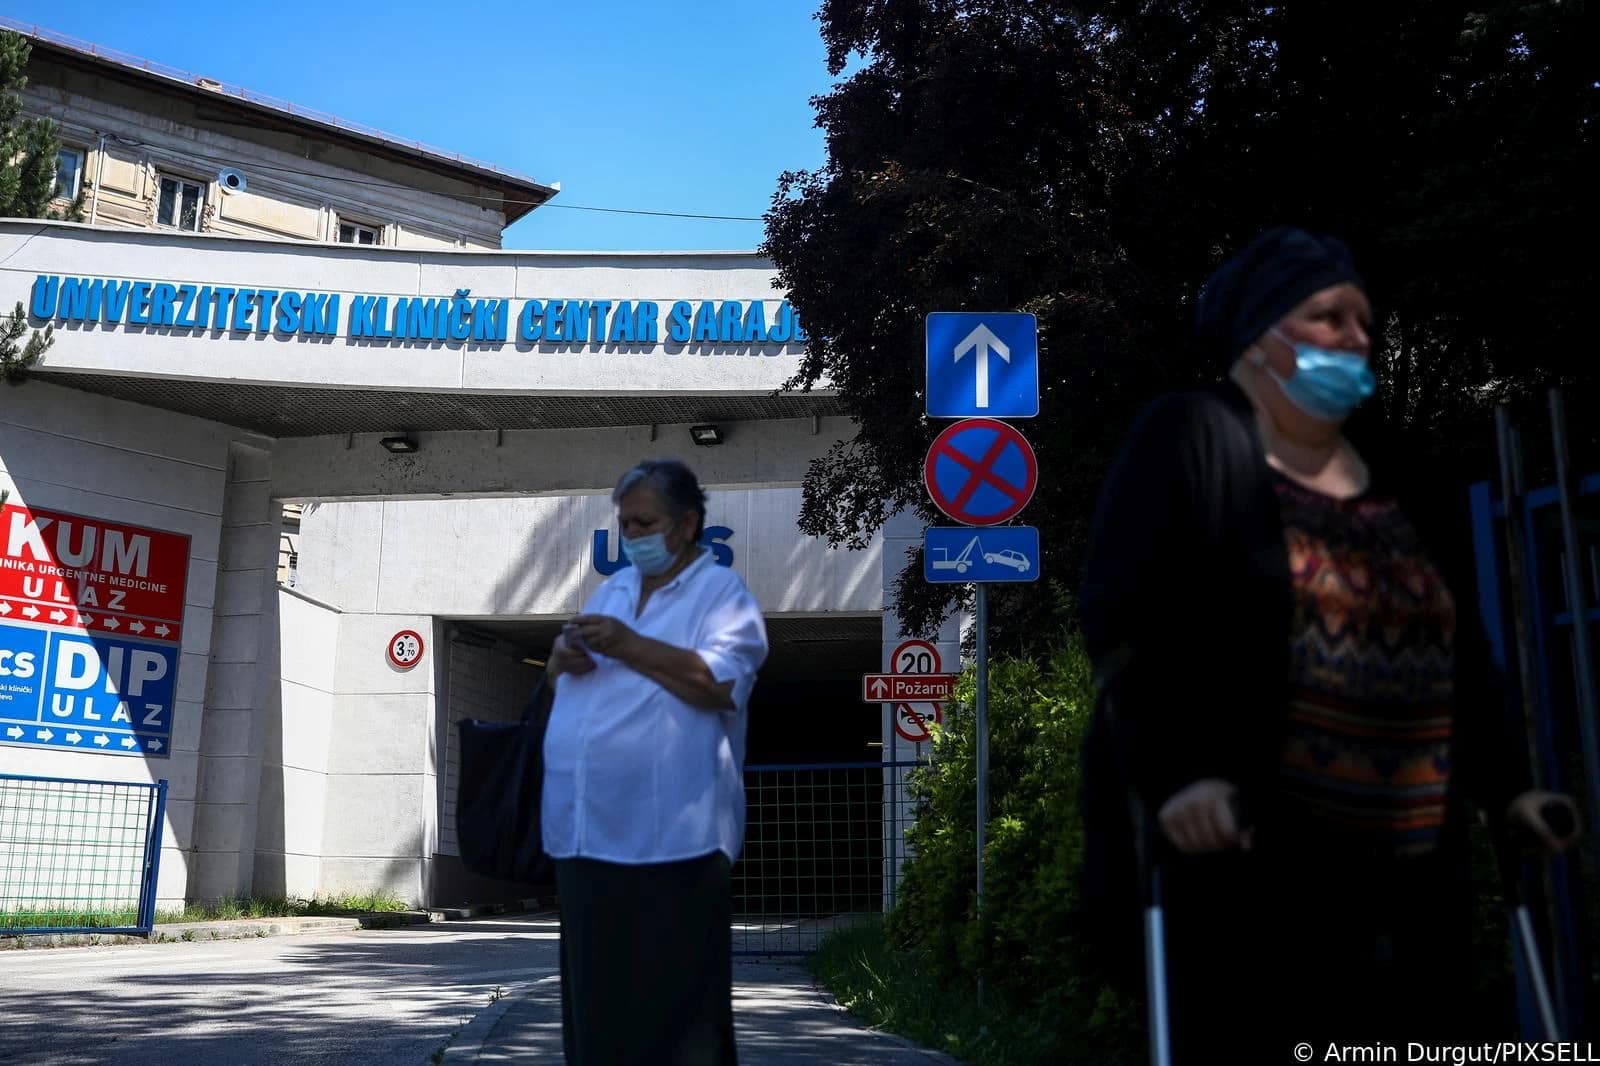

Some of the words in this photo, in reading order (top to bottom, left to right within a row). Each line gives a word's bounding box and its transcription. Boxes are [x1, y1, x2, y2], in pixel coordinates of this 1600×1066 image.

[32, 275, 340, 336] UNIVERZITETSKI
[350, 288, 508, 342] KLINIČKI
[522, 300, 659, 343] CENTAR
[672, 300, 808, 343] SARAJ
[7, 512, 151, 578] KUM
[0, 558, 35, 572] INIKA
[39, 564, 106, 583] URGENTNE
[109, 577, 168, 594] MEDICINE
[23, 576, 127, 611] ULAZ
[0, 650, 35, 678] CS
[396, 641, 405, 656] 3
[902, 653, 932, 674] 20
[54, 640, 168, 697] DIP
[896, 682, 948, 694] Požarni
[52, 694, 163, 726] ULAZ
